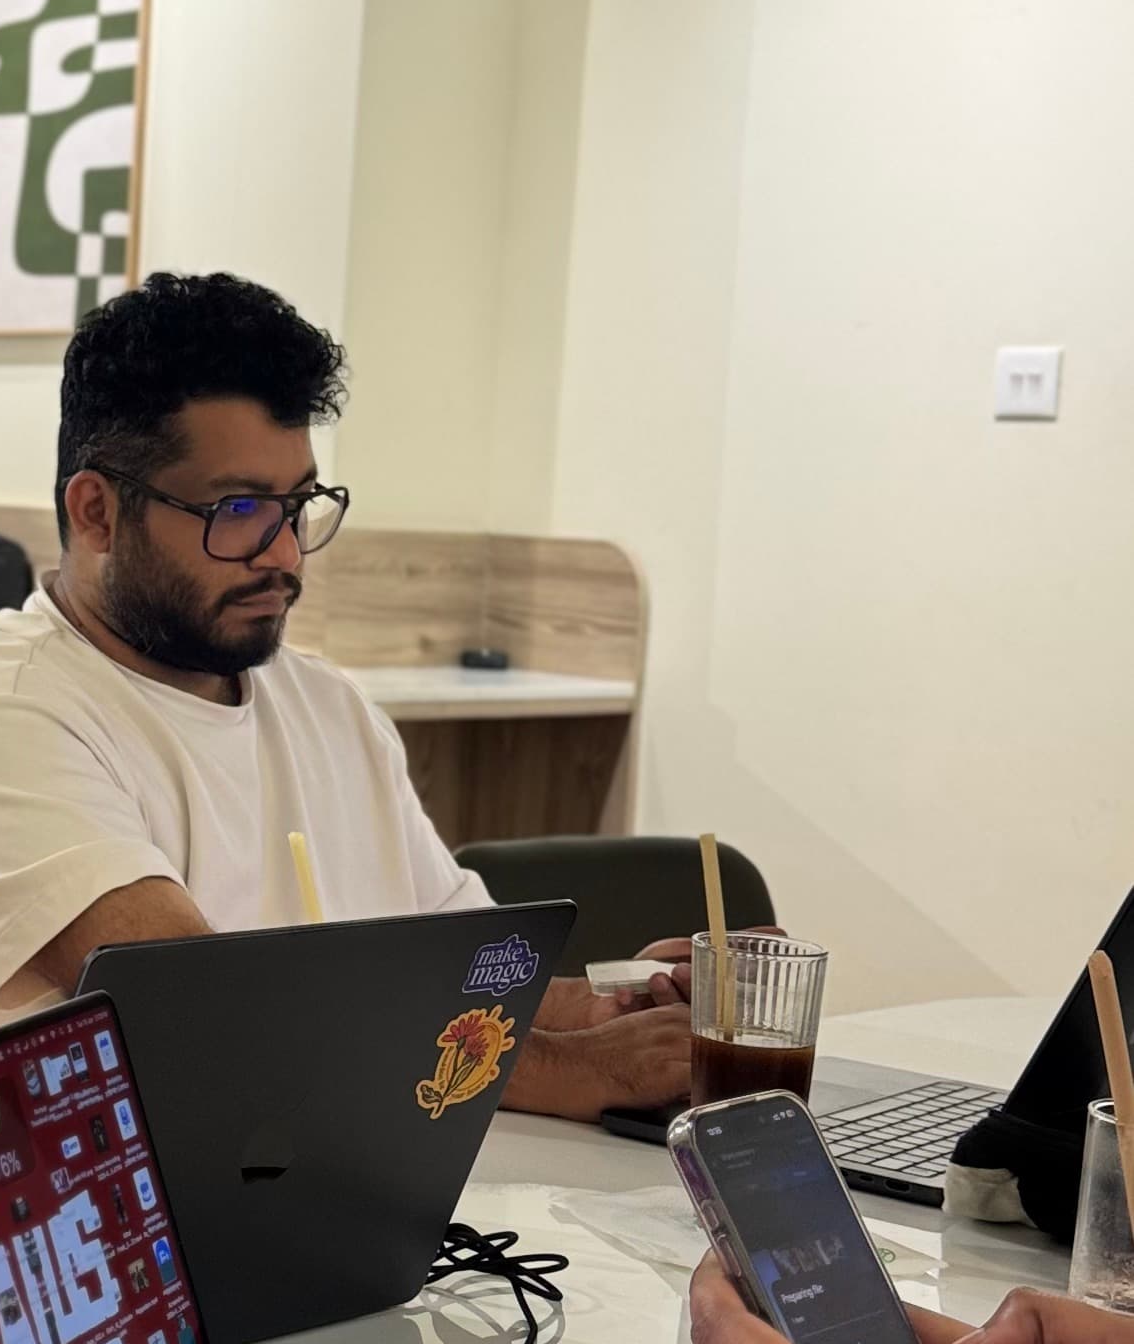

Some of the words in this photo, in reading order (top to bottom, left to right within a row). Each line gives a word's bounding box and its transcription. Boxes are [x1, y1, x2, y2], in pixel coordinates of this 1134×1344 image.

[477, 942, 523, 966] make
[469, 961, 532, 989] magic
[780, 1287, 815, 1305] Preparing
